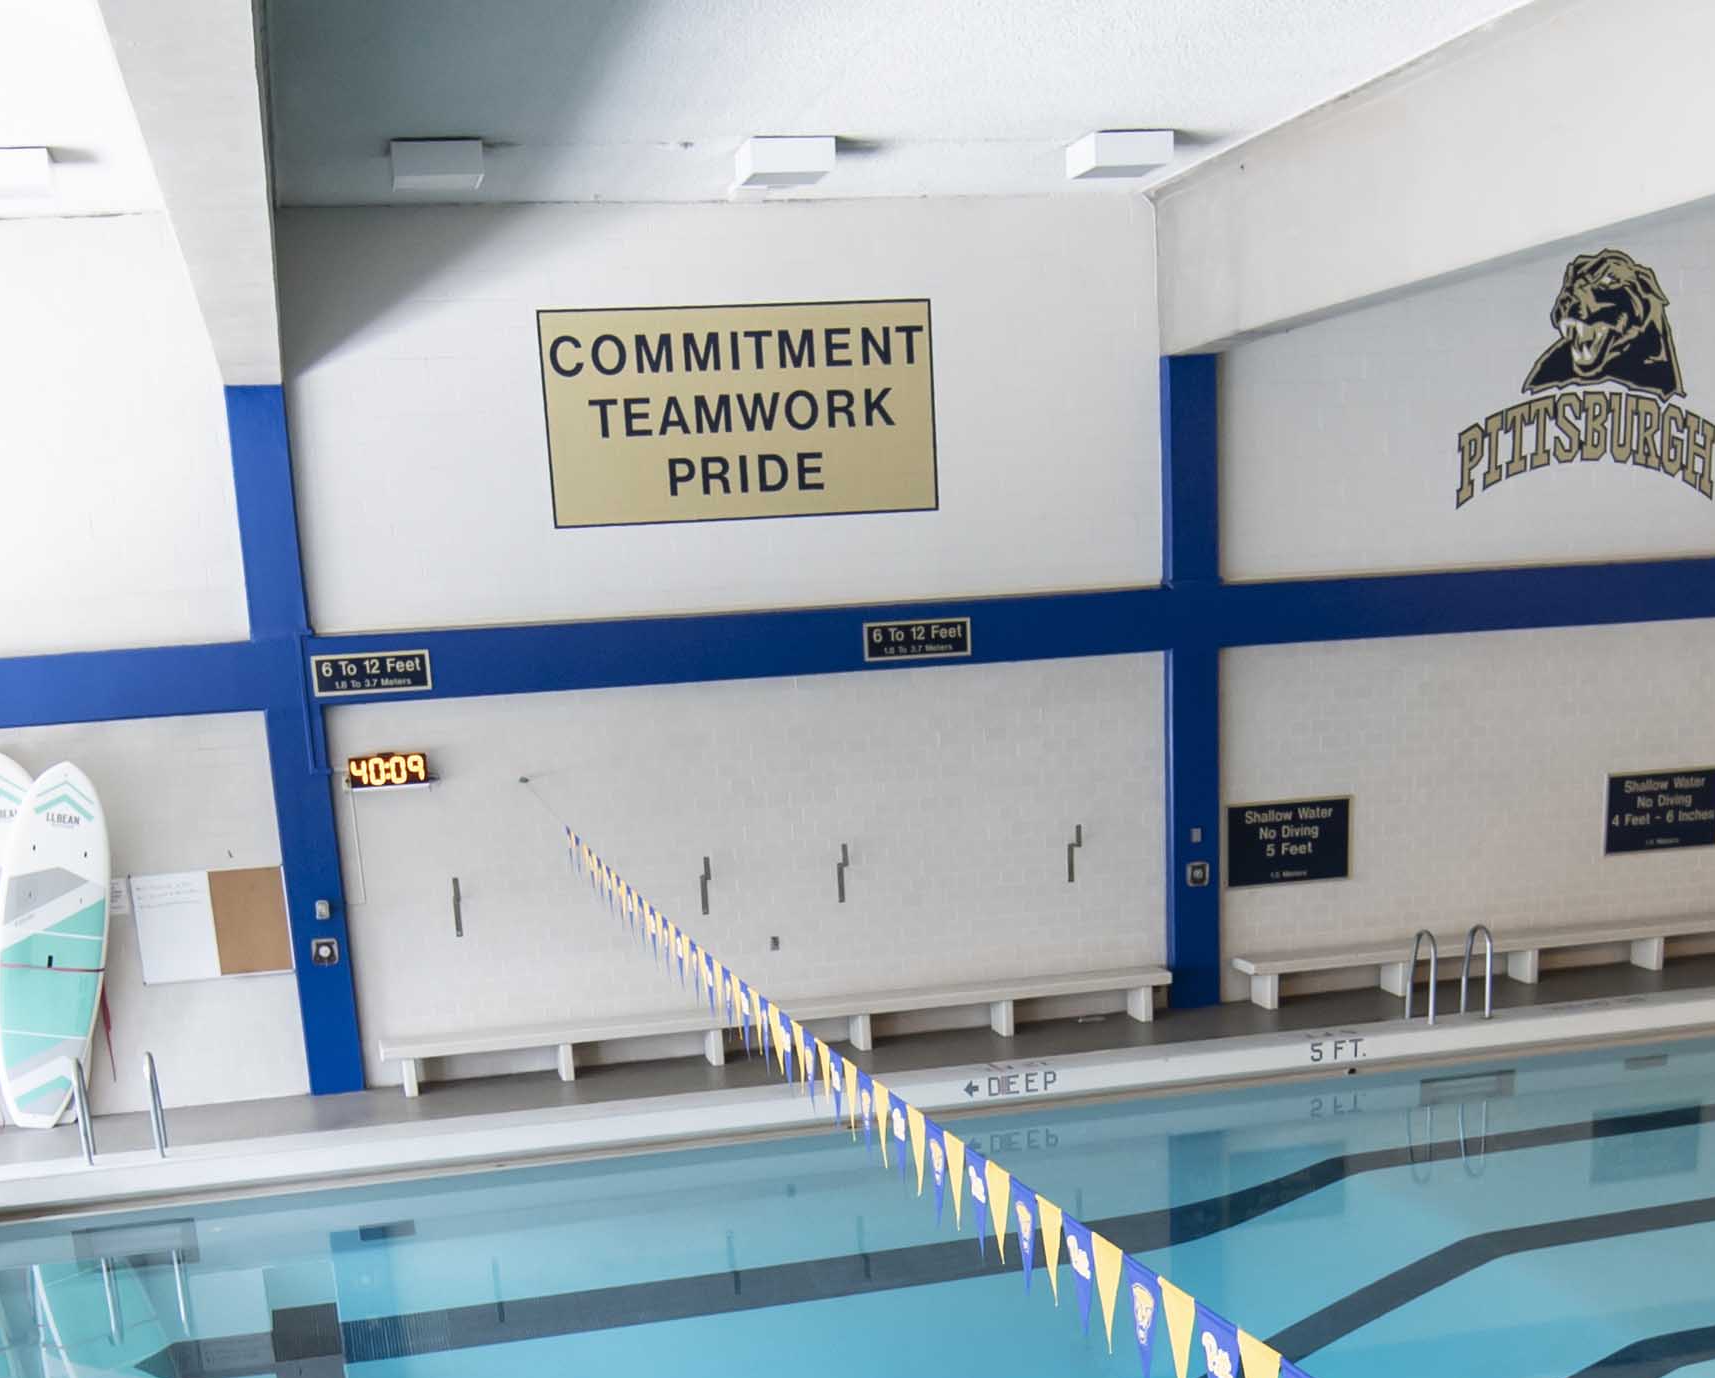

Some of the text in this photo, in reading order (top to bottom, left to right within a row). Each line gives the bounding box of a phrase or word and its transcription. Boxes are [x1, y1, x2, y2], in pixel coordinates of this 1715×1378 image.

[549, 325, 924, 378] COMMITMENT
[588, 387, 895, 438] TEAMWORK
[668, 452, 825, 496] PRIDE
[873, 624, 963, 643] 6 To 12 Feet
[321, 656, 422, 677] 6 To 12 Feet
[350, 680, 362, 689] To
[364, 679, 378, 688] 3.7
[381, 677, 412, 687] Meters
[349, 754, 425, 786] 40:09
[1624, 776, 1706, 793] Shallow Water
[1637, 794, 1693, 809] No Diving
[1245, 806, 1333, 825] Shallow Water
[1612, 814, 1620, 827] 4
[1624, 812, 1650, 826] Feet
[1666, 811, 1674, 824] 6
[1678, 808, 1715, 822] Inches
[1259, 825, 1319, 841] No Diving
[1266, 841, 1313, 857] 5 Feet
[1311, 1038, 1367, 1062] 5 FT.
[988, 1070, 1057, 1097] DEEP
